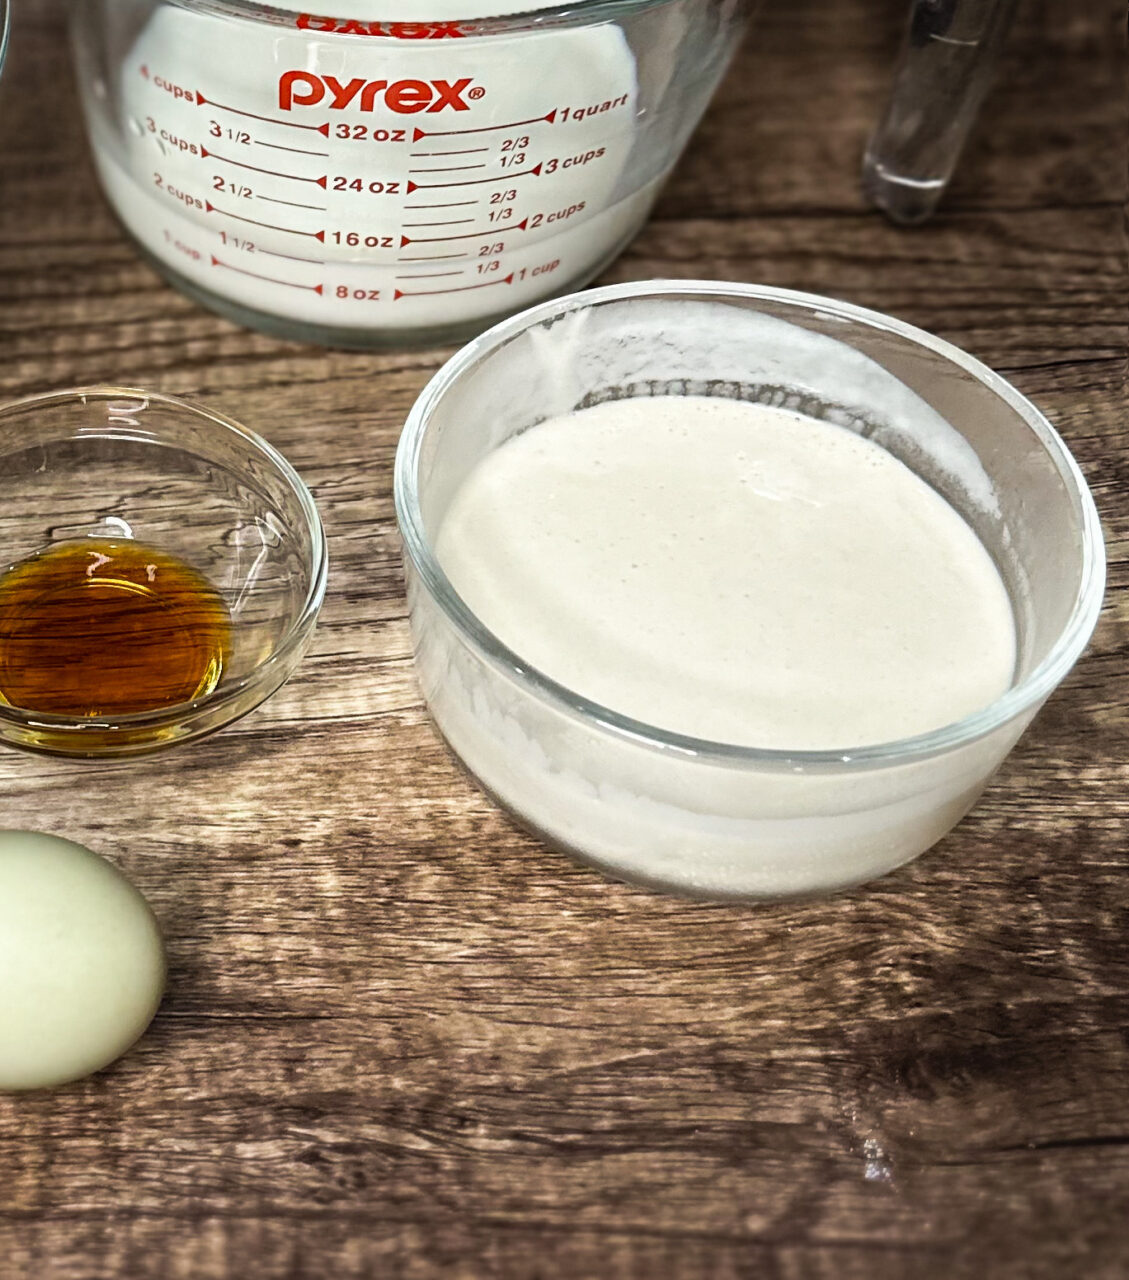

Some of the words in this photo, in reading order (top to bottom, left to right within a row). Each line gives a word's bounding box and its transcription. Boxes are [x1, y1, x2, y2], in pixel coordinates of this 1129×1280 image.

[154, 75, 194, 102] cups
[146, 116, 157, 133] 3
[160, 129, 198, 155] cups
[335, 123, 368, 140] 32
[373, 129, 406, 142] oz
[500, 136, 530, 152] 2/3
[500, 153, 526, 168] 1/3
[544, 158, 559, 175] 3
[562, 146, 607, 170] cups
[154, 172, 163, 189] 2
[166, 184, 203, 210] cups
[333, 177, 363, 193] 24
[369, 182, 400, 194] oz
[489, 189, 517, 205] 2/3
[488, 208, 513, 222] 1/3
[530, 214, 544, 229] 2
[547, 200, 587, 224] cups
[332, 232, 359, 247] 16
[364, 237, 393, 248] oz
[478, 242, 505, 257] 2/3
[477, 260, 500, 274] 1/3
[519, 267, 526, 280] 1
[531, 258, 561, 278] cup
[336, 286, 348, 301] 8
[353, 290, 380, 300] oz
